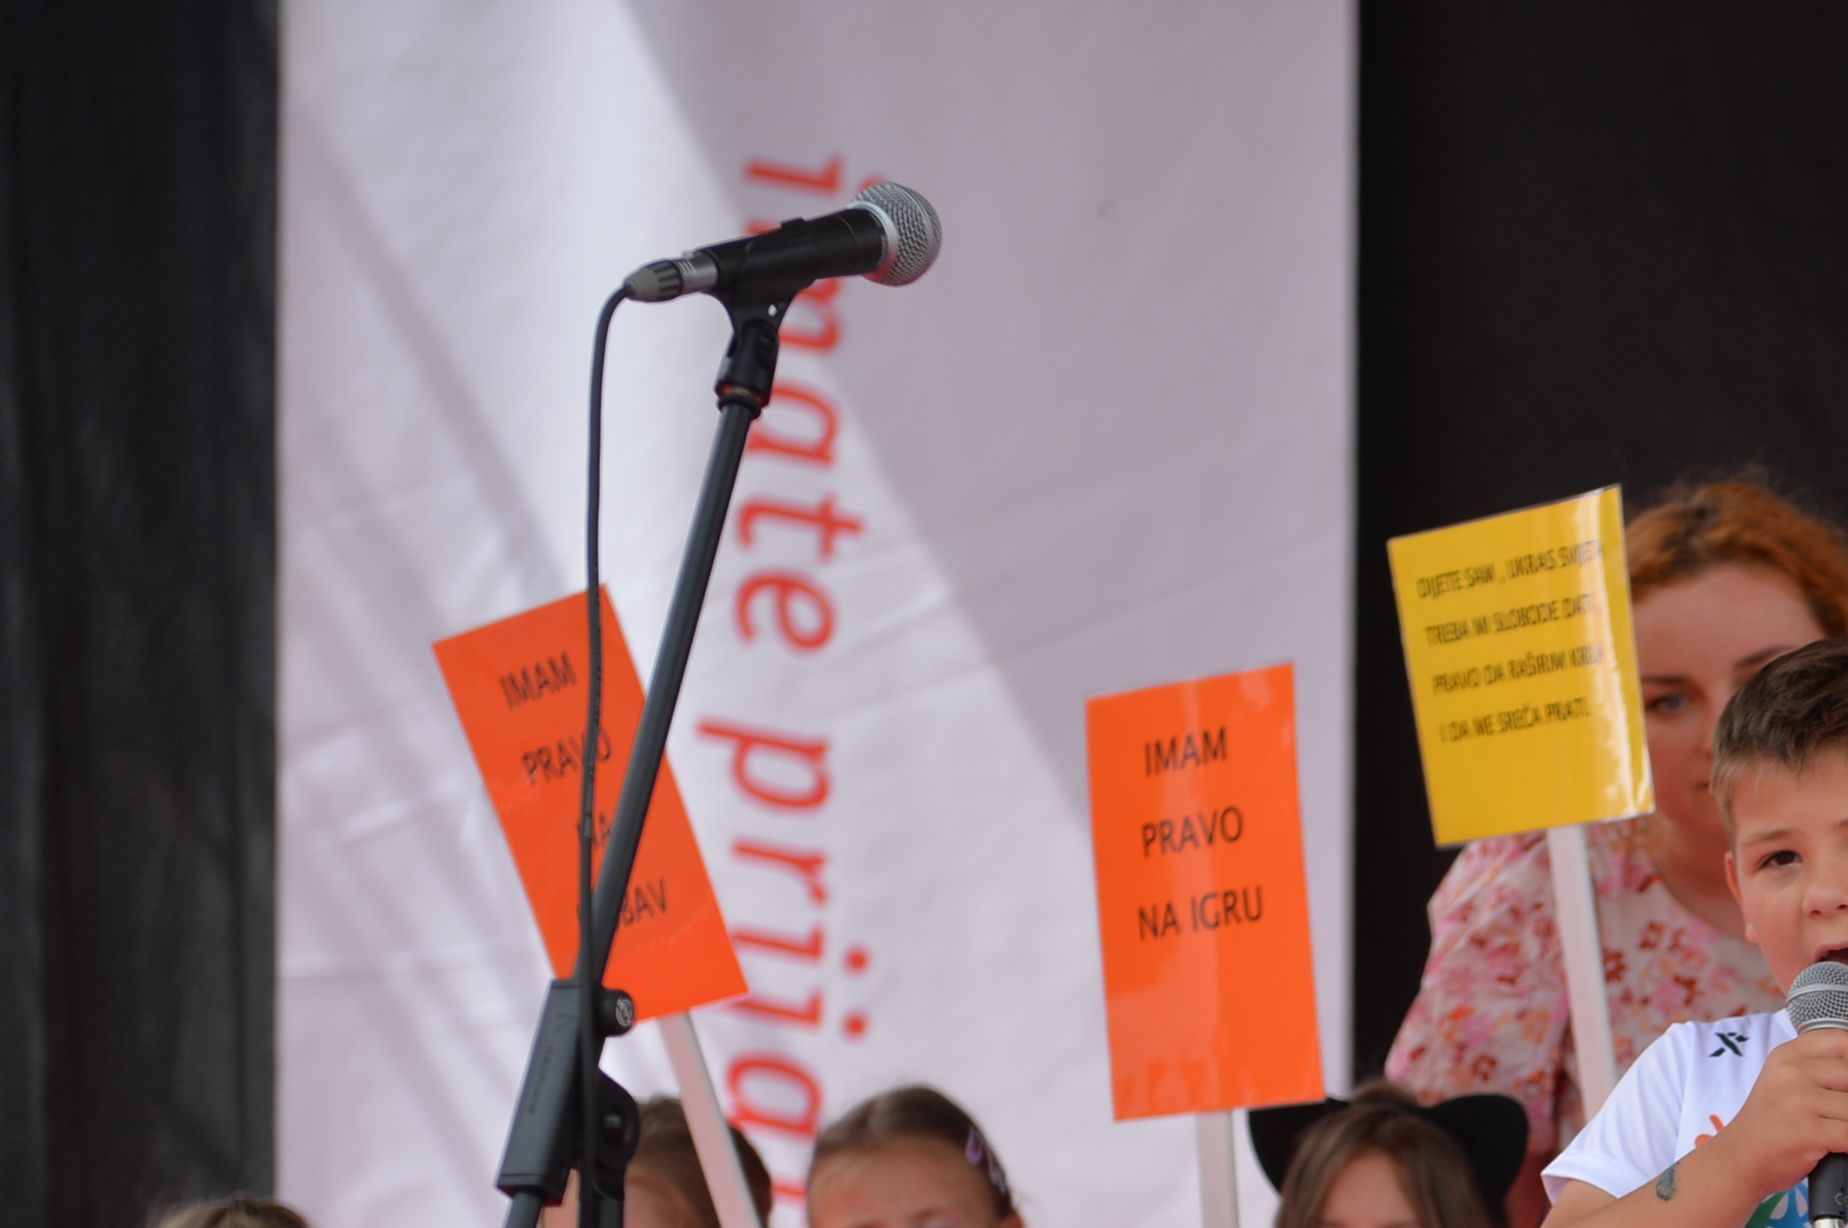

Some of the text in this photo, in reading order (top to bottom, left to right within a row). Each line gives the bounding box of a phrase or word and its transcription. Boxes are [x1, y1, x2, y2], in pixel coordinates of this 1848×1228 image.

[498, 650, 579, 711] IMAM
[1144, 726, 1229, 778] IMAM
[1141, 805, 1245, 860] PRAVO
[1137, 885, 1264, 942] NA IGRU
